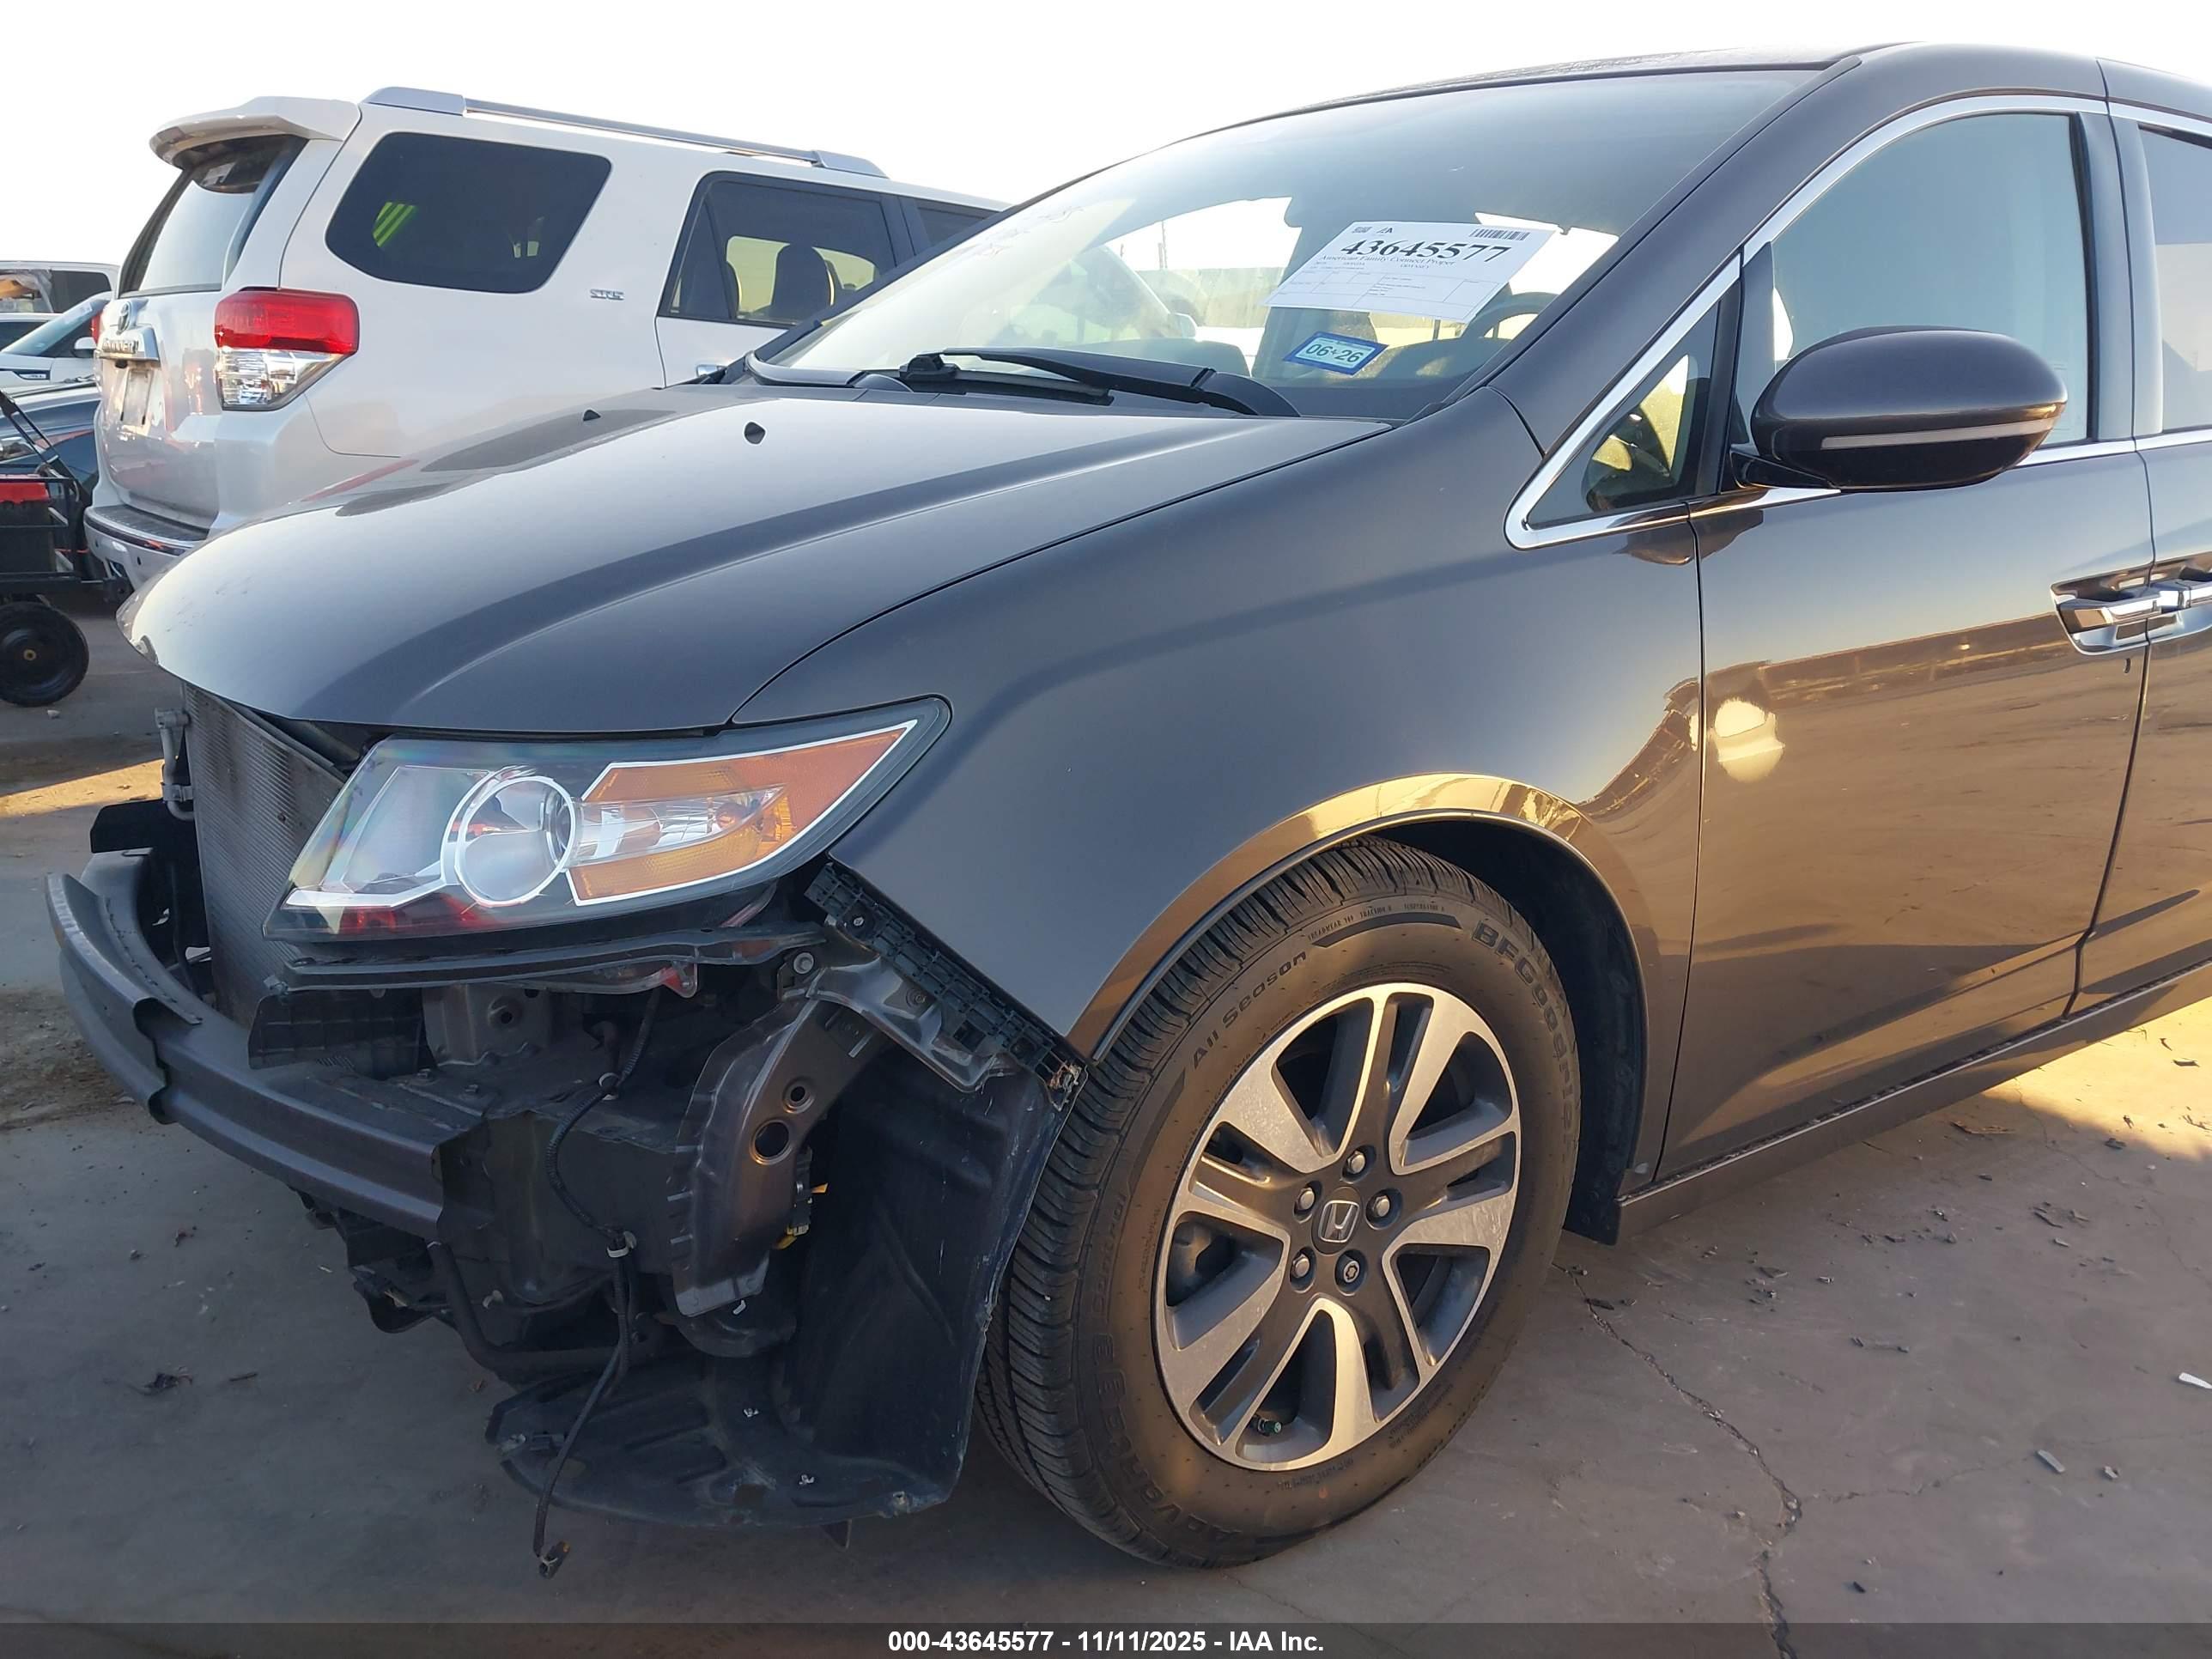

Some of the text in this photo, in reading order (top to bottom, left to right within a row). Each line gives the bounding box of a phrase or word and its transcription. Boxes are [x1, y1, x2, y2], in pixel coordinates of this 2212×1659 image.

[1340, 239, 1511, 263] 43645577
[1193, 1030, 1220, 1070] All
[1222, 951, 1307, 1030] Season
